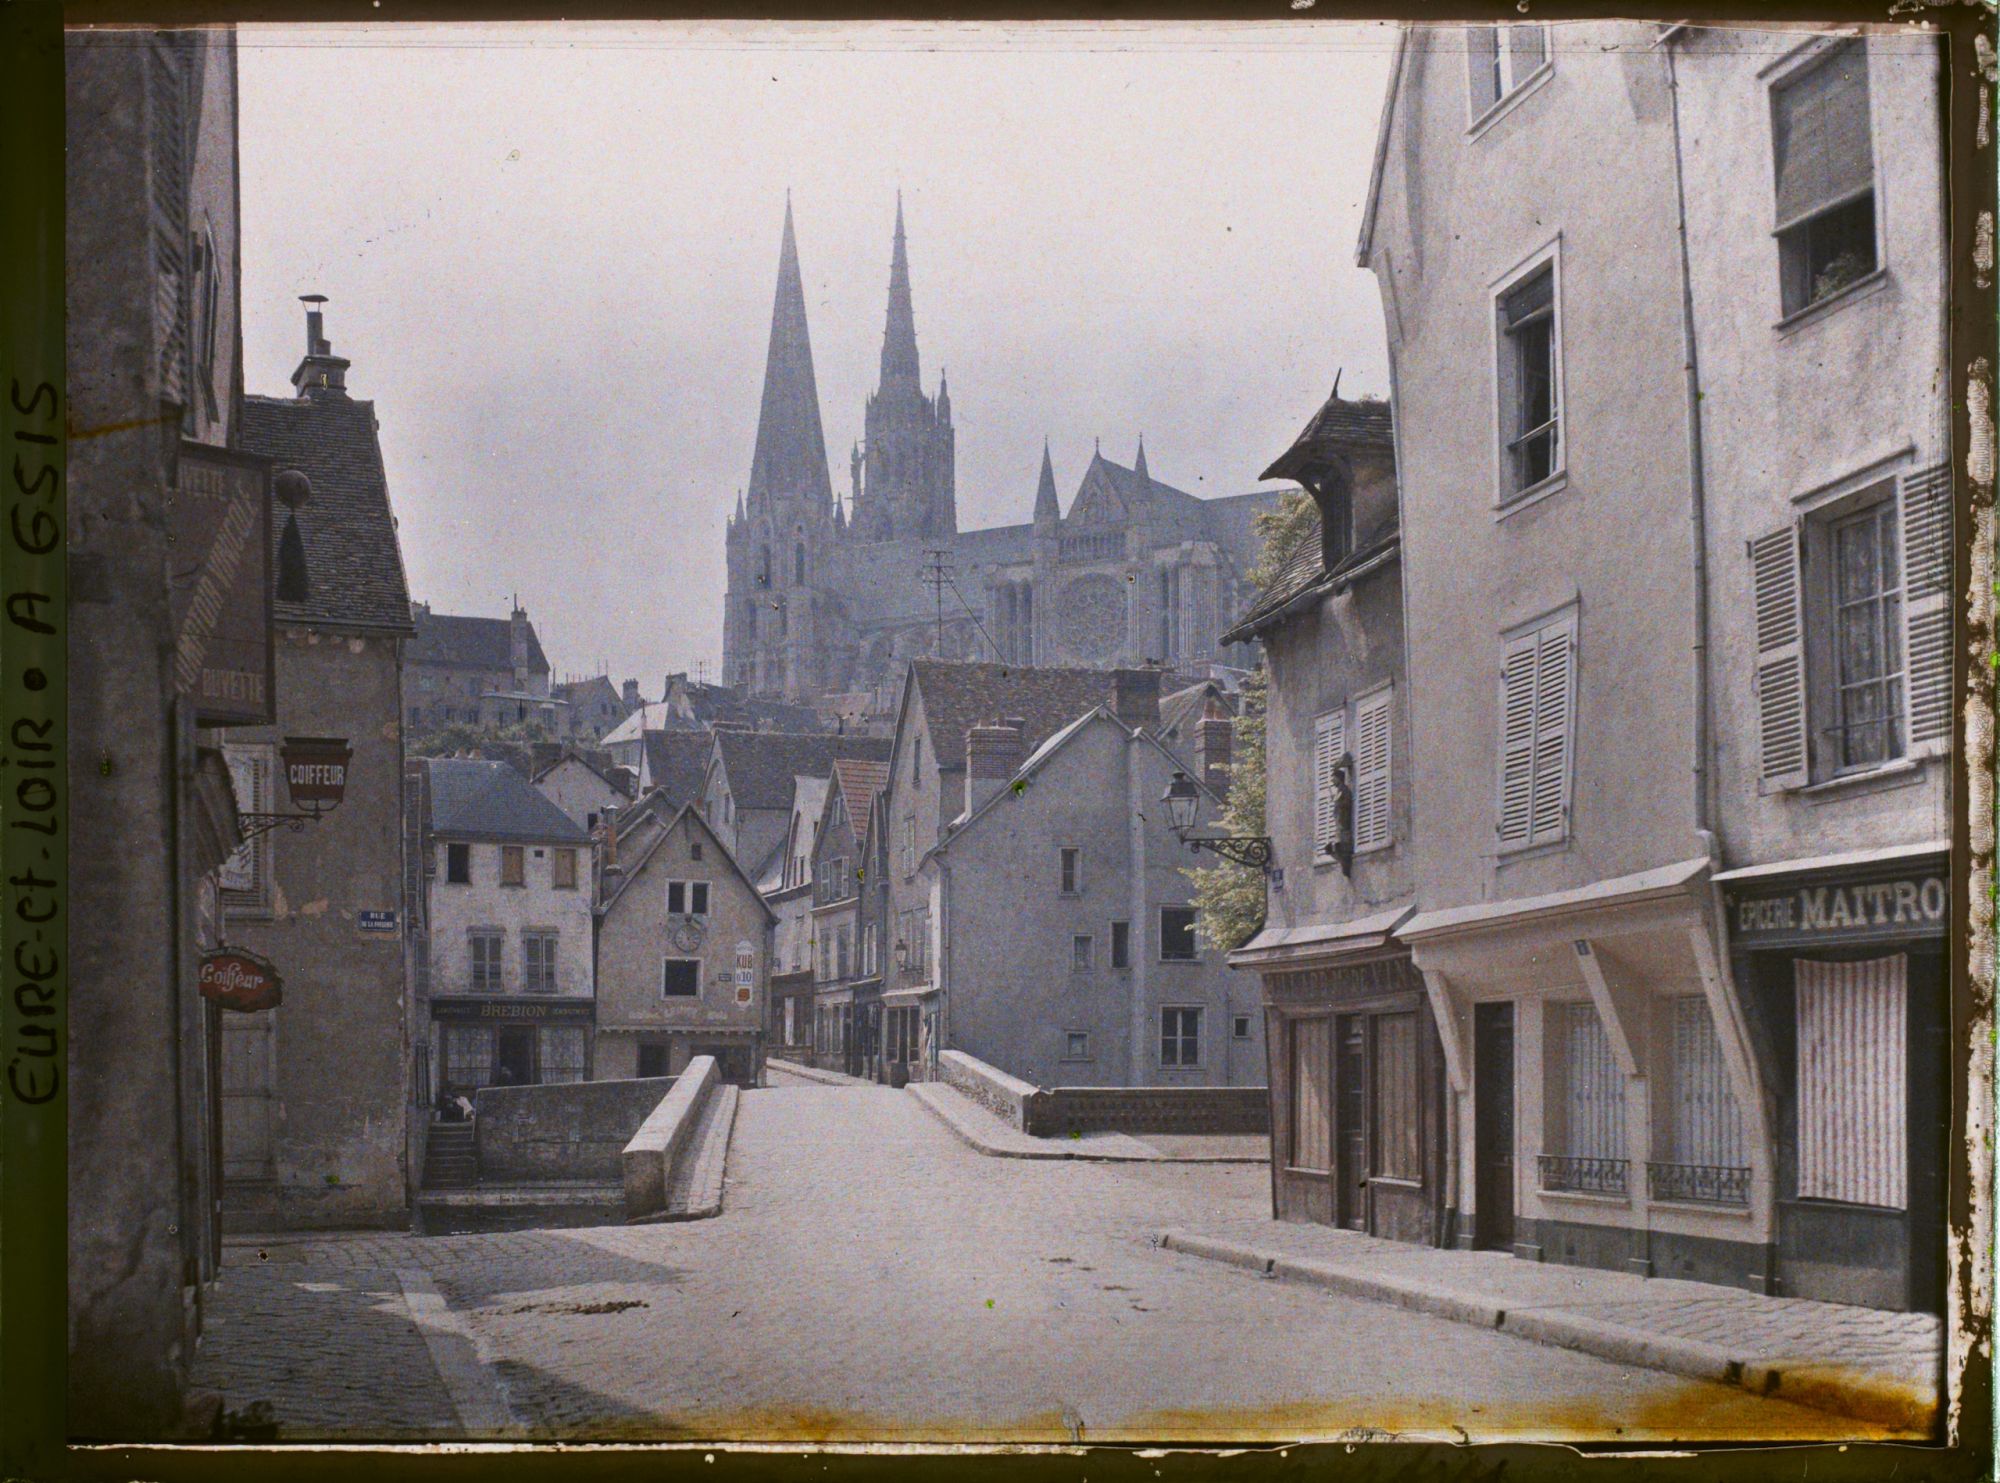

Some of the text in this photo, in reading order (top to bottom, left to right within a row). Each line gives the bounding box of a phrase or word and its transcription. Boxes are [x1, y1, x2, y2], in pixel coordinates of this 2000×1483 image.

[203, 667, 264, 702] BUVETTE
[289, 764, 344, 786] COIFFEUR
[370, 911, 386, 920] RUE
[736, 954, 753, 969] KUB
[200, 963, 264, 992] Coiffeur
[481, 1004, 547, 1017] BREBION
